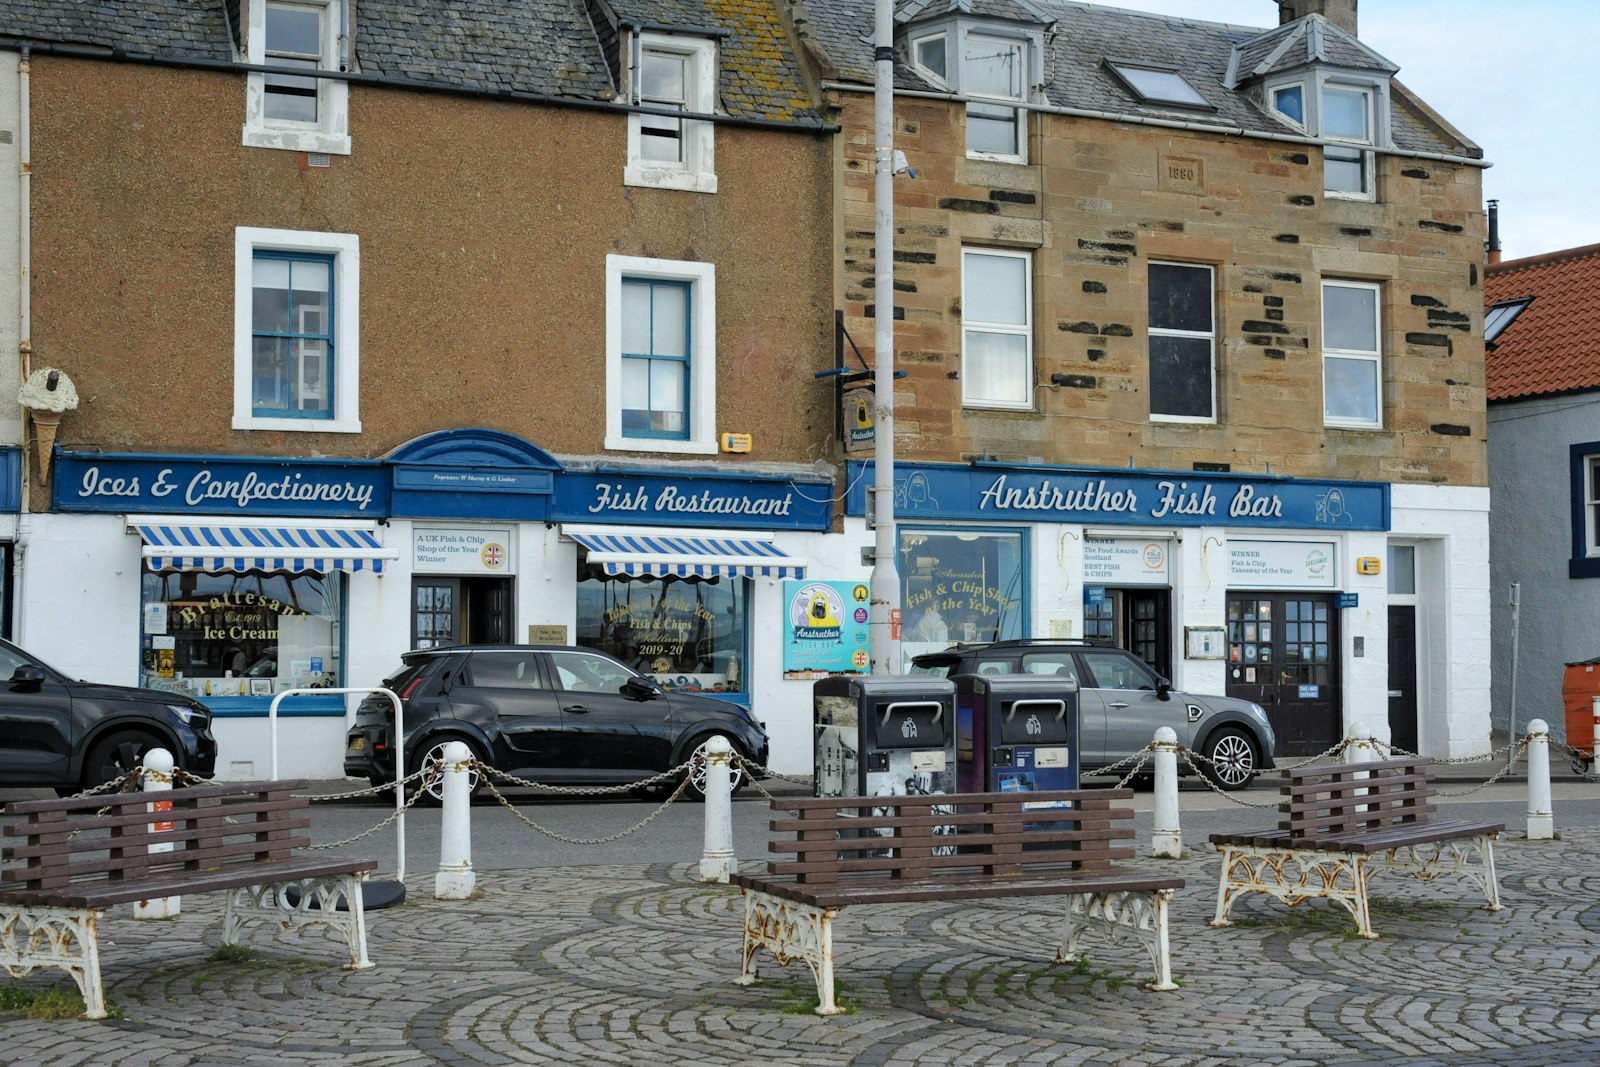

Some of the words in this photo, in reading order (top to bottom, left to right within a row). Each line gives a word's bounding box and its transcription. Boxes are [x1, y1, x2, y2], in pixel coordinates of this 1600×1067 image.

[1168, 166, 1194, 181] 1880
[78, 467, 140, 497] Ices
[151, 469, 178, 497] &
[185, 470, 374, 510] Confectionery
[980, 475, 1137, 513] Anstruther
[1152, 481, 1216, 517] Fish
[1230, 484, 1282, 517] Bar
[589, 483, 648, 513] Fish
[654, 486, 792, 516] Restaurant
[466, 536, 485, 544] Chip
[417, 545, 437, 553] Shop
[907, 587, 932, 609] Fish
[936, 583, 948, 595] &
[952, 581, 983, 597] Chip
[986, 587, 1016, 611] Shop
[179, 591, 307, 624] Brattesani
[694, 601, 716, 622] Year
[942, 598, 963, 610] the
[969, 598, 998, 616] Year
[243, 613, 261, 623] 1919
[629, 619, 651, 629] Fish
[652, 619, 661, 629] &
[664, 618, 692, 630] Chips
[204, 626, 226, 640] Ice
[229, 626, 281, 640] Cream
[795, 627, 840, 638] Anstruther
